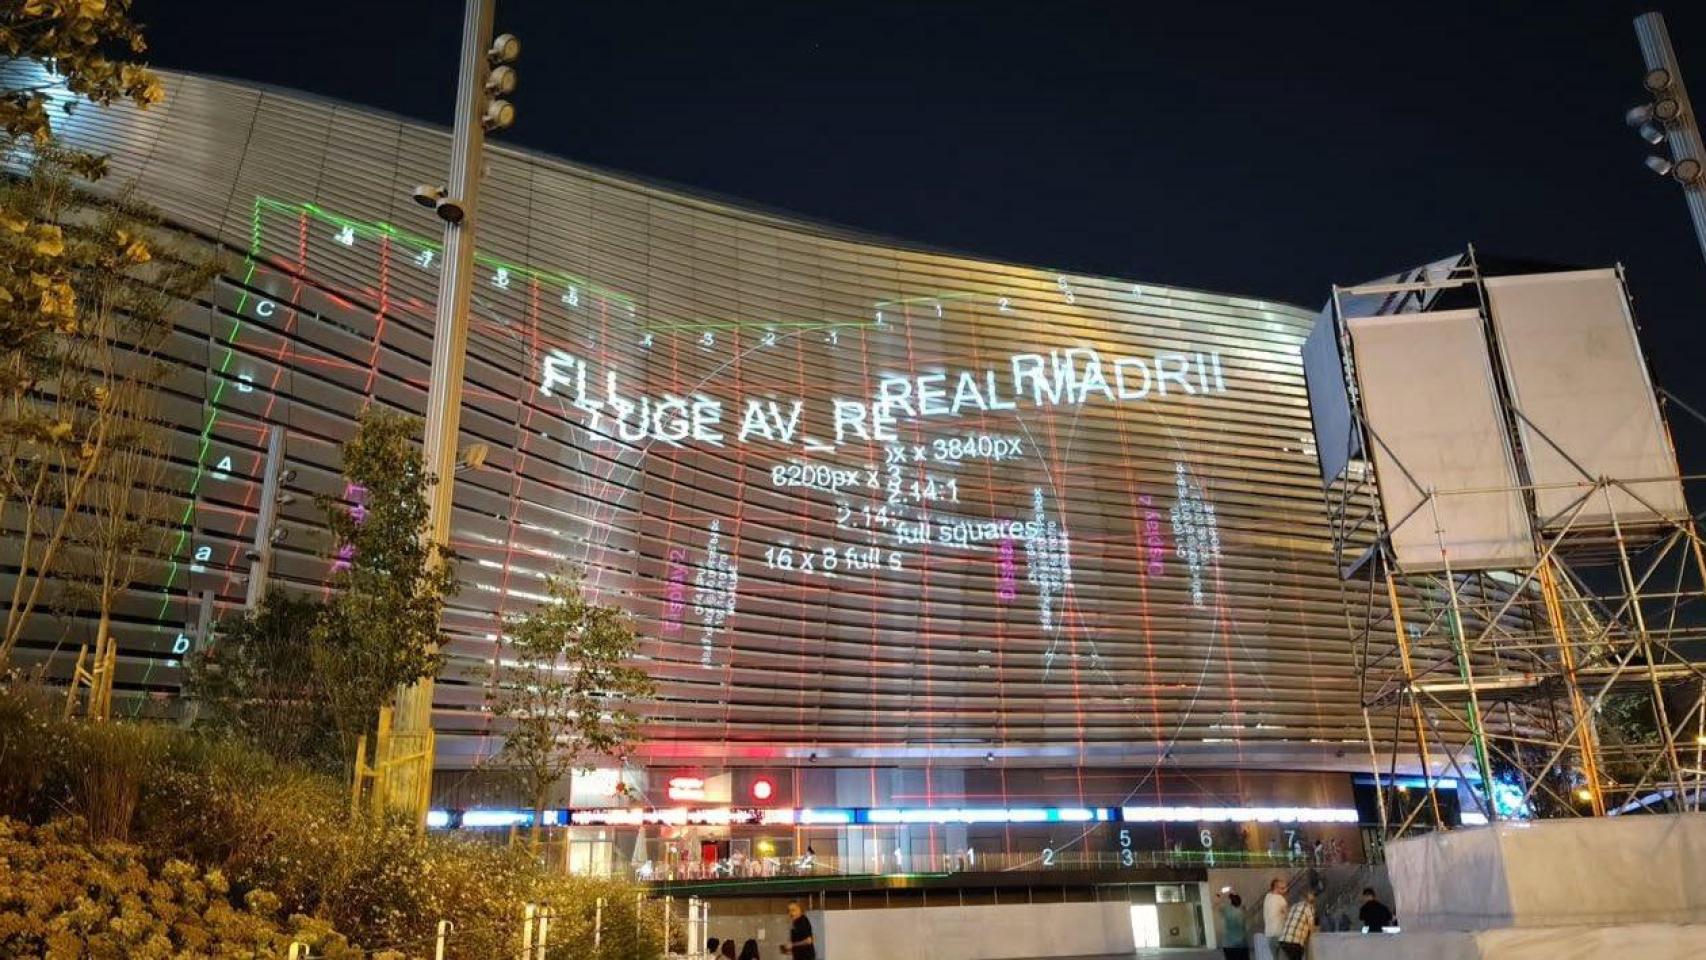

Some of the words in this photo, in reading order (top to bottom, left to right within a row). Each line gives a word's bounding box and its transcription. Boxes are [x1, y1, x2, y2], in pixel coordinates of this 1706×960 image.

[932, 436, 1024, 464] 3840px
[212, 455, 233, 480] A
[894, 522, 931, 545] full
[190, 546, 212, 569] a
[800, 550, 814, 573] x
[845, 546, 881, 570] full
[171, 633, 190, 655] b
[1119, 829, 1132, 847] 5
[1200, 829, 1213, 848] 6
[1042, 848, 1054, 866] 2
[1121, 849, 1133, 867] 3
